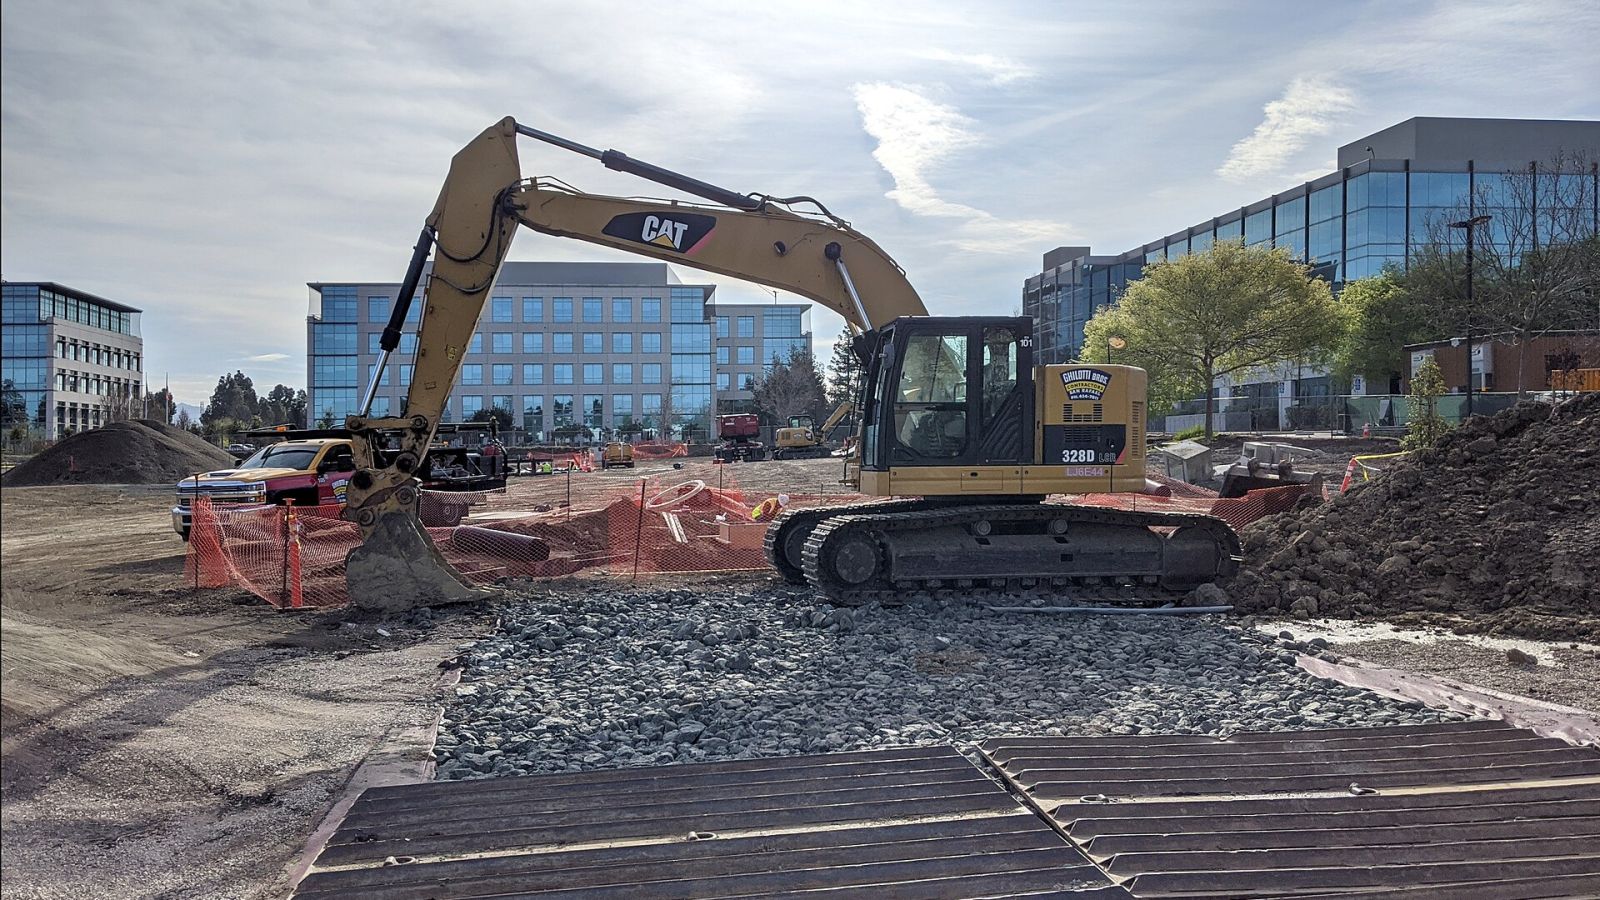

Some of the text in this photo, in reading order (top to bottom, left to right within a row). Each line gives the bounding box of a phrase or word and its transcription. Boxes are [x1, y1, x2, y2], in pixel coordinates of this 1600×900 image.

[641, 215, 689, 250] CAT
[1020, 339, 1033, 347] 101
[1062, 370, 1091, 383] GHILOTTI
[1066, 382, 1104, 391] CONTRACTORS
[1062, 449, 1095, 462] 328D
